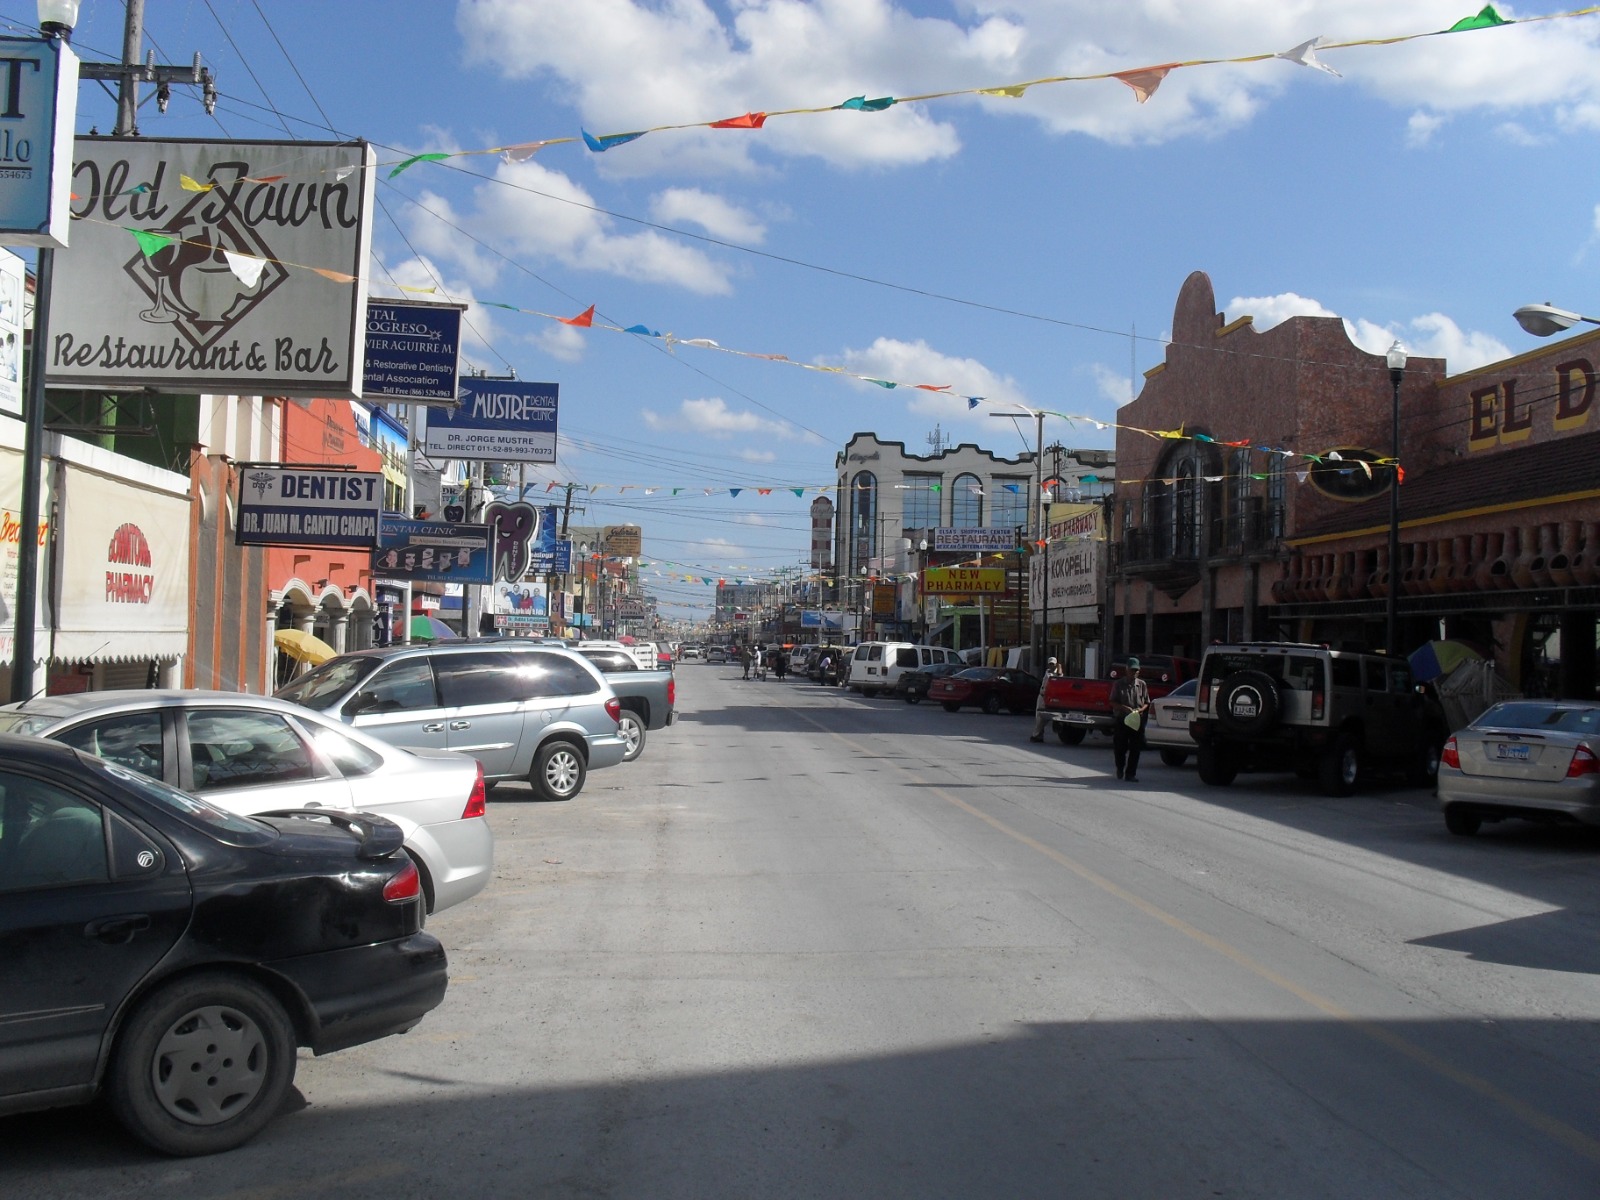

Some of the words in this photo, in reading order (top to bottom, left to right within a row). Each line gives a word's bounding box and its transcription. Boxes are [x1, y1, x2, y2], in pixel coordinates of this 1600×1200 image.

[70, 159, 169, 222] Old
[199, 161, 358, 230] Town
[53, 332, 244, 371] Restaurant
[246, 341, 268, 372] &
[274, 337, 339, 374] Bar
[390, 340, 439, 353] AGUIRRE
[441, 344, 455, 354] M.
[364, 359, 371, 368] &
[373, 359, 417, 371] Restorative
[419, 362, 454, 375] Dentistry
[385, 374, 439, 385] Association
[382, 386, 394, 394] Toll
[395, 387, 408, 395] Free
[409, 388, 425, 396] (866)
[472, 393, 530, 420] MUSTRE
[530, 395, 556, 407] DENTAL
[532, 410, 554, 422] CLINIC
[1469, 378, 1533, 450] EL
[448, 434, 463, 442] DR.
[465, 435, 496, 443] JORGE
[497, 436, 534, 445] MUSTRE
[281, 474, 377, 501] DENTIST
[243, 512, 260, 533] DR.
[261, 513, 288, 534] JUAN
[289, 514, 302, 534] M.
[303, 514, 339, 536] CANTU
[340, 515, 376, 537] CHAPA
[420, 526, 457, 536] CLINIC
[1063, 512, 1099, 538] PHARMACY
[107, 523, 152, 569] DOWNTOWN
[936, 534, 1013, 544] RESTAURANT
[948, 569, 980, 580] NEW
[1050, 552, 1093, 580] KOKOPELLI
[105, 570, 155, 605] PHARMACY
[927, 581, 1002, 591] PHARMACY
